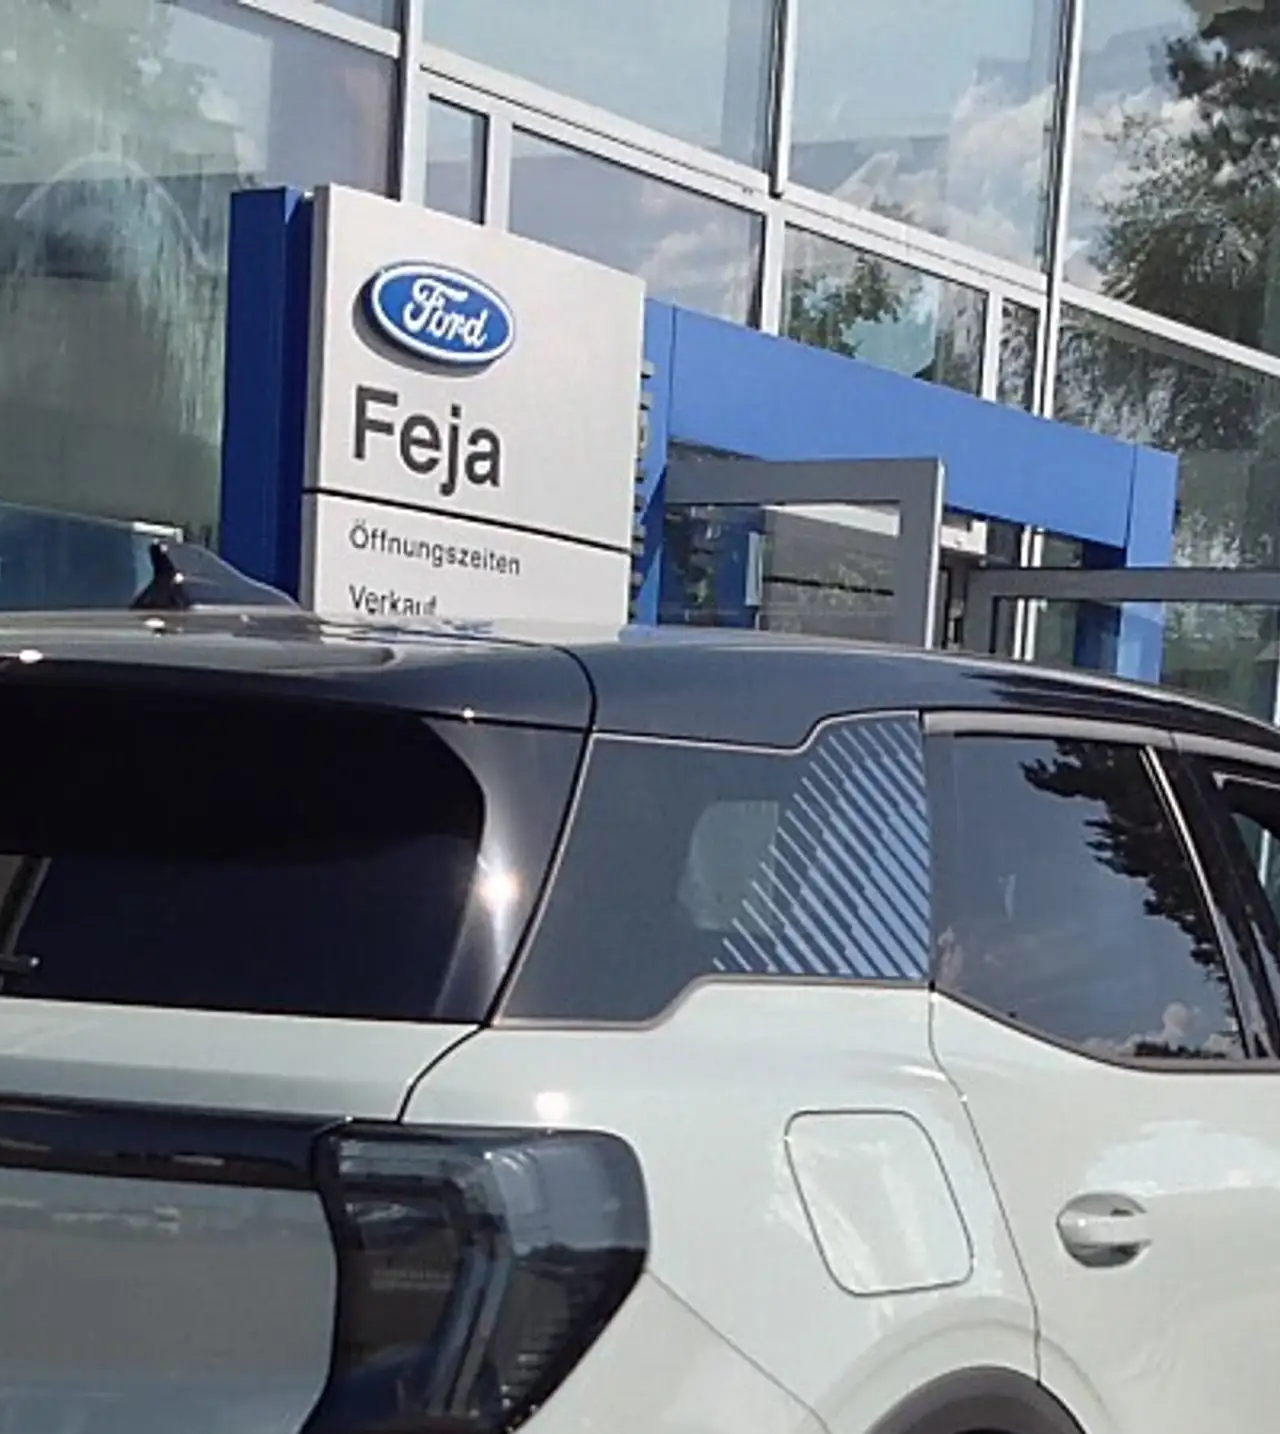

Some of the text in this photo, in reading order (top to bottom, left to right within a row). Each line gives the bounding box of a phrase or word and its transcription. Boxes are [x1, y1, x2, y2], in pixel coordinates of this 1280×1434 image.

[402, 278, 489, 349] Ford
[352, 384, 503, 497] Feja
[349, 518, 521, 576] Öffnungszeiten
